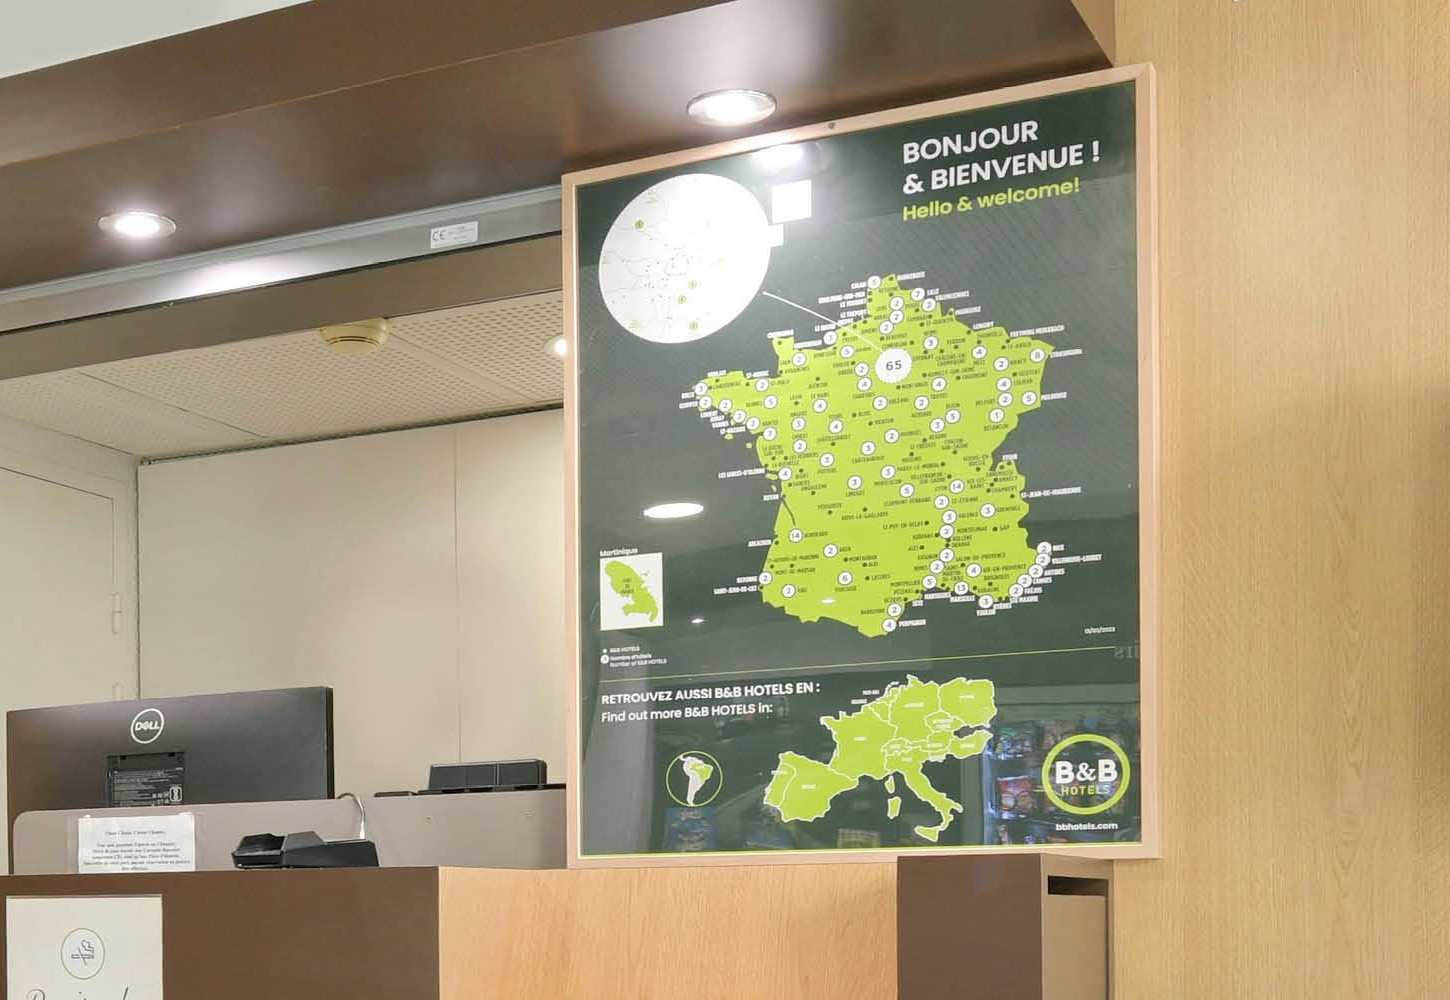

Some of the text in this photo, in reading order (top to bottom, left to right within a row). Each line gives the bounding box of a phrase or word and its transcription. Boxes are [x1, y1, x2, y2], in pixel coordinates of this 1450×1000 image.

[903, 120, 1039, 164] BONJOUR
[902, 173, 925, 195] &
[931, 143, 1084, 190] BIENVENUE
[903, 176, 1081, 222] Hello & welcome!
[886, 361, 902, 370] 65
[599, 547, 639, 557] Martinique
[601, 691, 672, 705] RETROUVEZ
[675, 688, 712, 701] AUSSI
[714, 687, 742, 699] B&B
[744, 683, 794, 697] HOTELS
[796, 682, 813, 694] EN
[601, 703, 773, 723] Find out more B&B HOTELS in:
[134, 720, 161, 732] DELL
[1055, 758, 1118, 784] B&B
[1061, 785, 1110, 797] HOTELS
[1055, 821, 1118, 832] bbhotels.com
